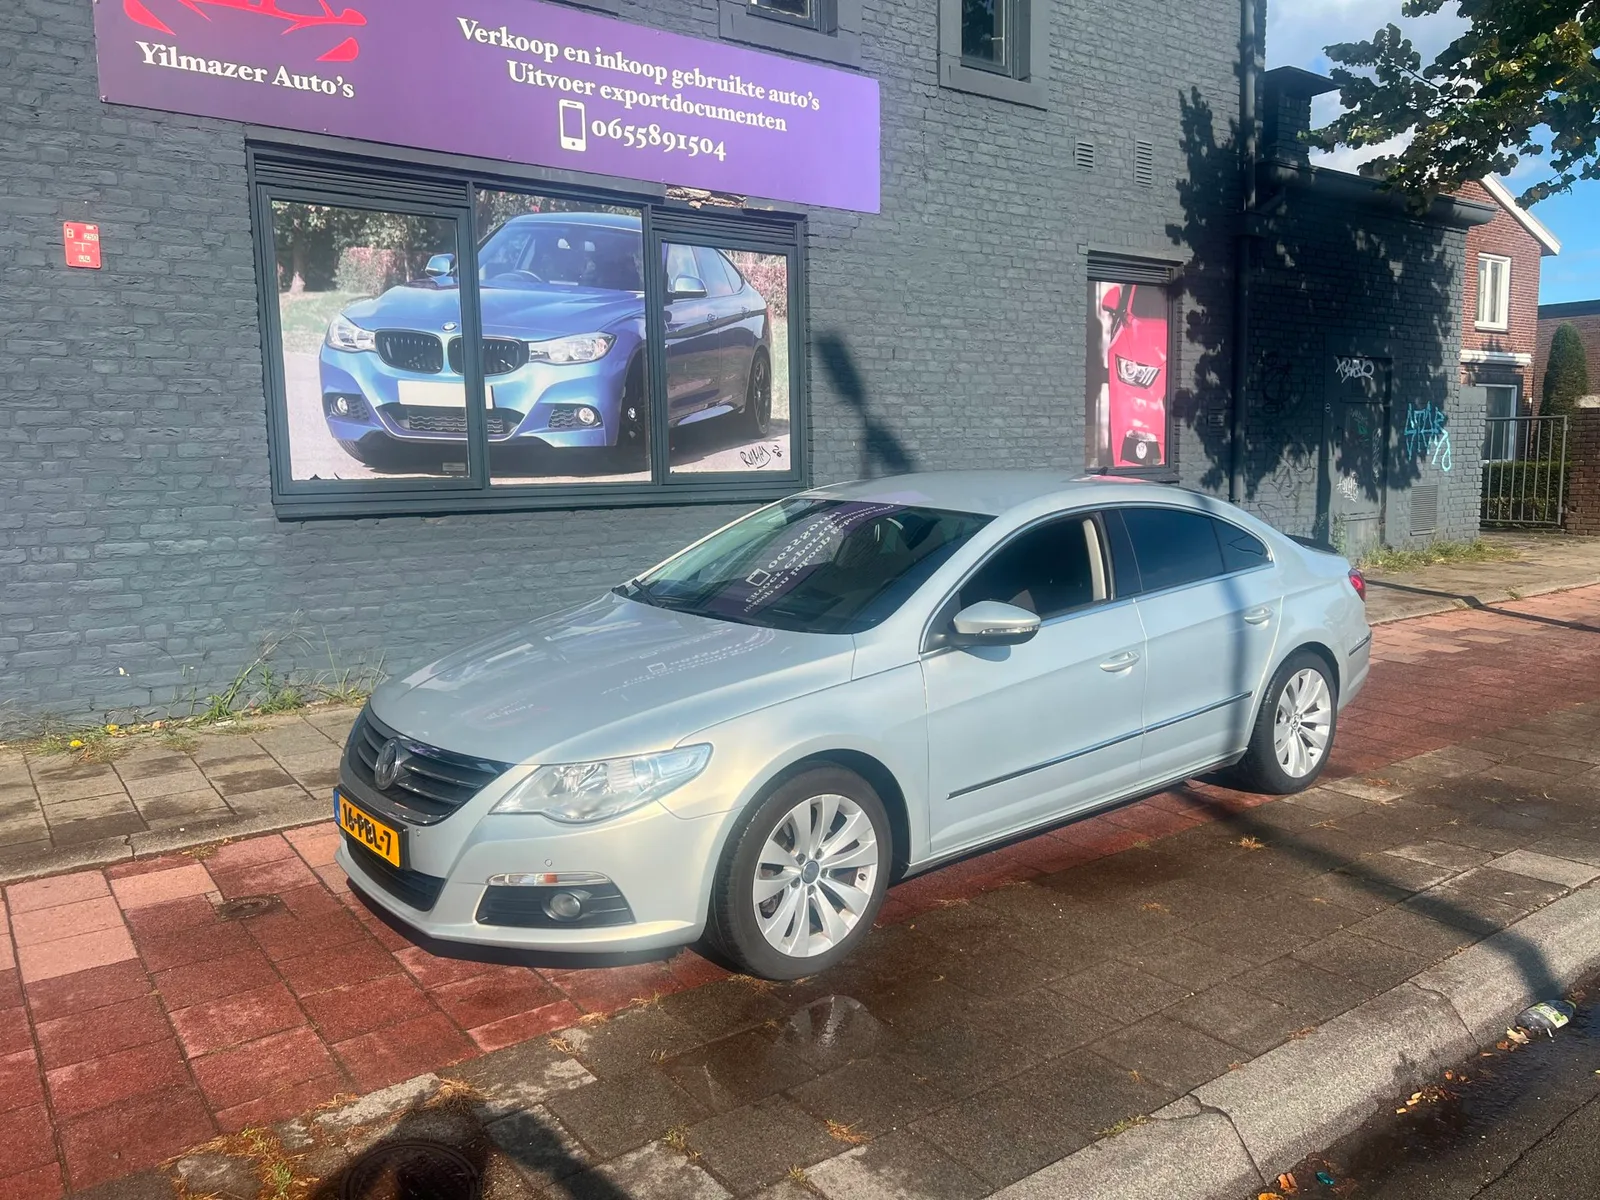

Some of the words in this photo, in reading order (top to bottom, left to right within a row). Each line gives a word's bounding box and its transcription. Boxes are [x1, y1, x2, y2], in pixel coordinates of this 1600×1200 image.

[135, 40, 268, 83] Yilmazer
[271, 65, 354, 98] Auto's
[457, 17, 559, 64] Verkoop
[563, 47, 592, 65] en
[595, 46, 668, 86] inkoop
[671, 67, 766, 100] gebruikte
[768, 89, 820, 111] auto's
[507, 59, 596, 97] Uitvoer
[600, 85, 788, 132] exportdocumenten
[591, 118, 727, 162] 0655891504
[343, 803, 392, 856] 16-PBL-7
